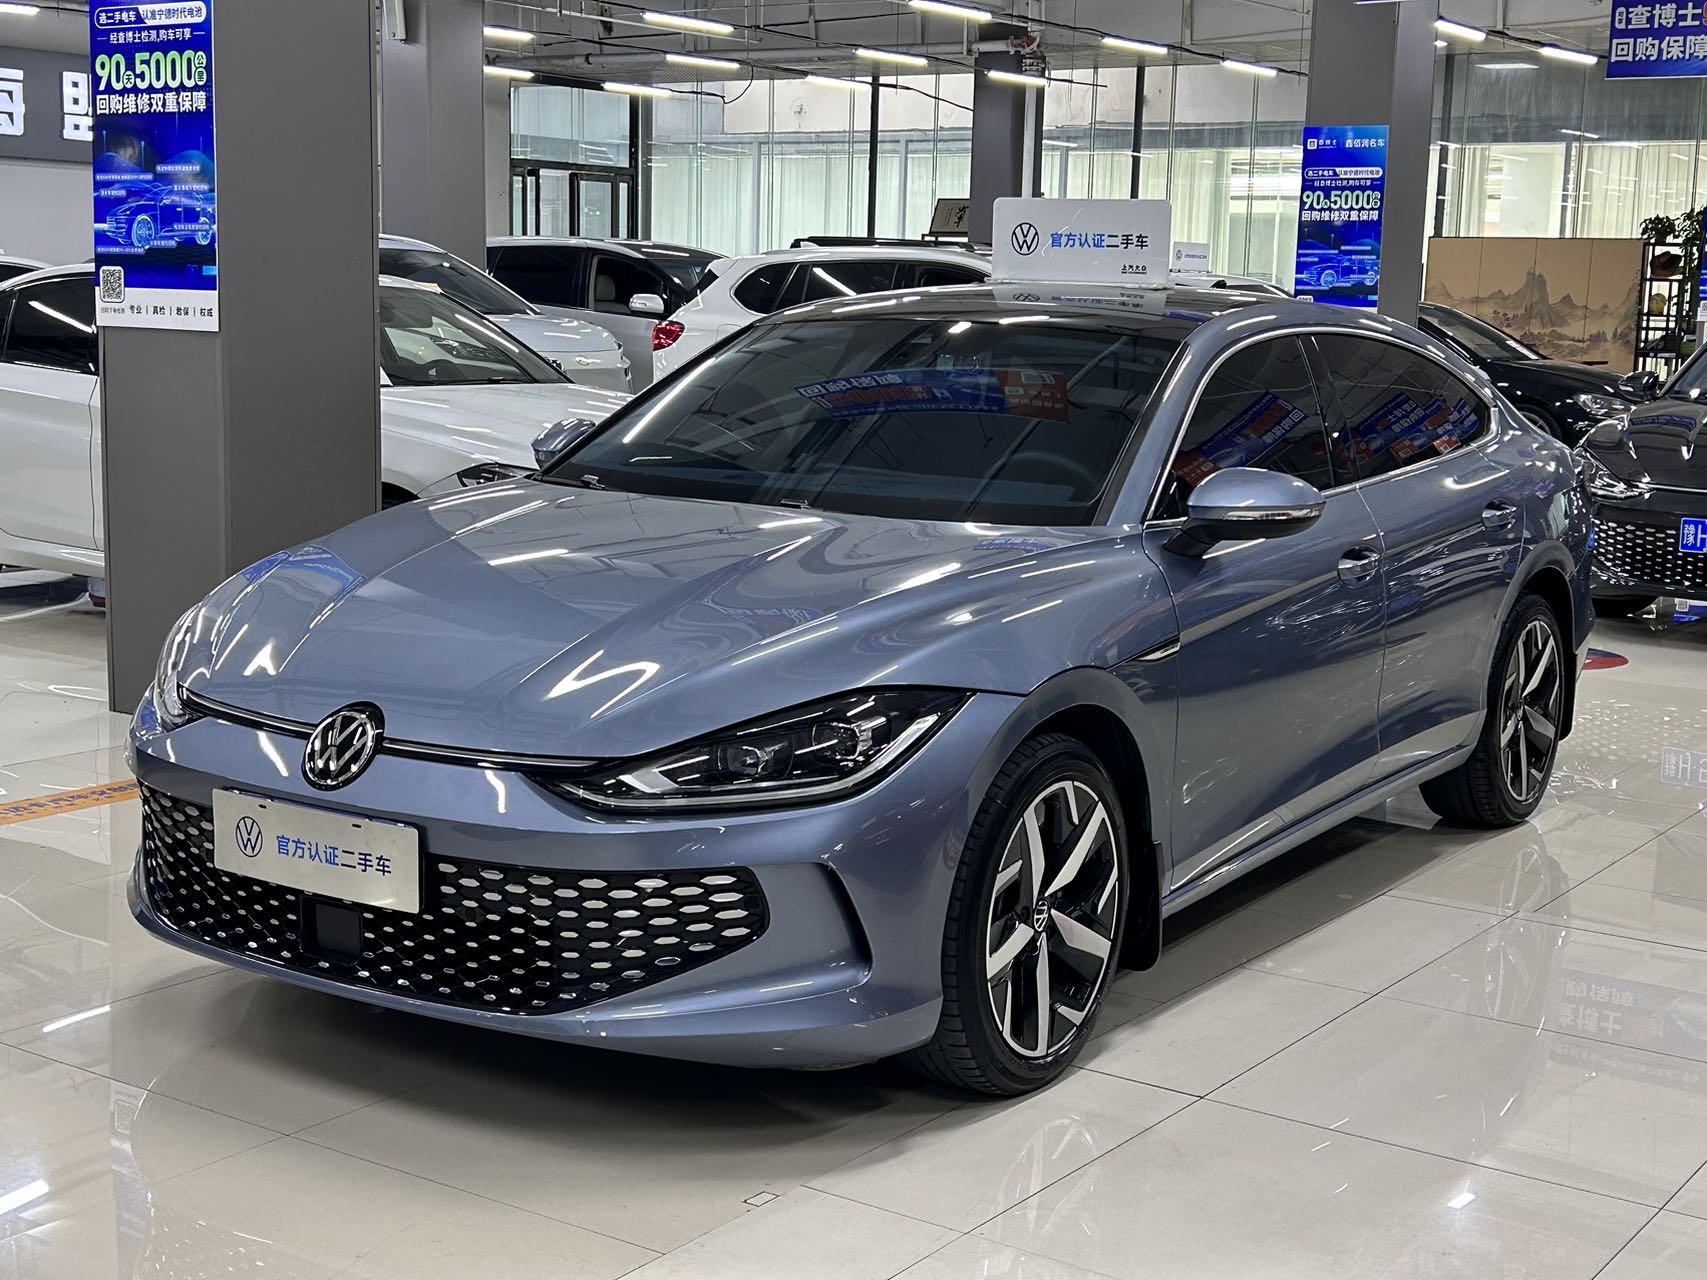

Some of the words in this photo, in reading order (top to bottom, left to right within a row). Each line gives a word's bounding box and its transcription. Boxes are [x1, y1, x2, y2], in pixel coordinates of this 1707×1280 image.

[99, 11, 136, 24] 选二手电车
[142, 6, 203, 21] 认准宁德时代电池
[1628, 2, 1707, 29] 查博士
[1611, 34, 1707, 62] 回购保障
[96, 91, 207, 115] 回购维修双重保障
[1302, 210, 1379, 221] 回购维修双重保障
[1050, 233, 1149, 250] 官方认证二手车
[276, 835, 391, 876] 官方认证二手车
